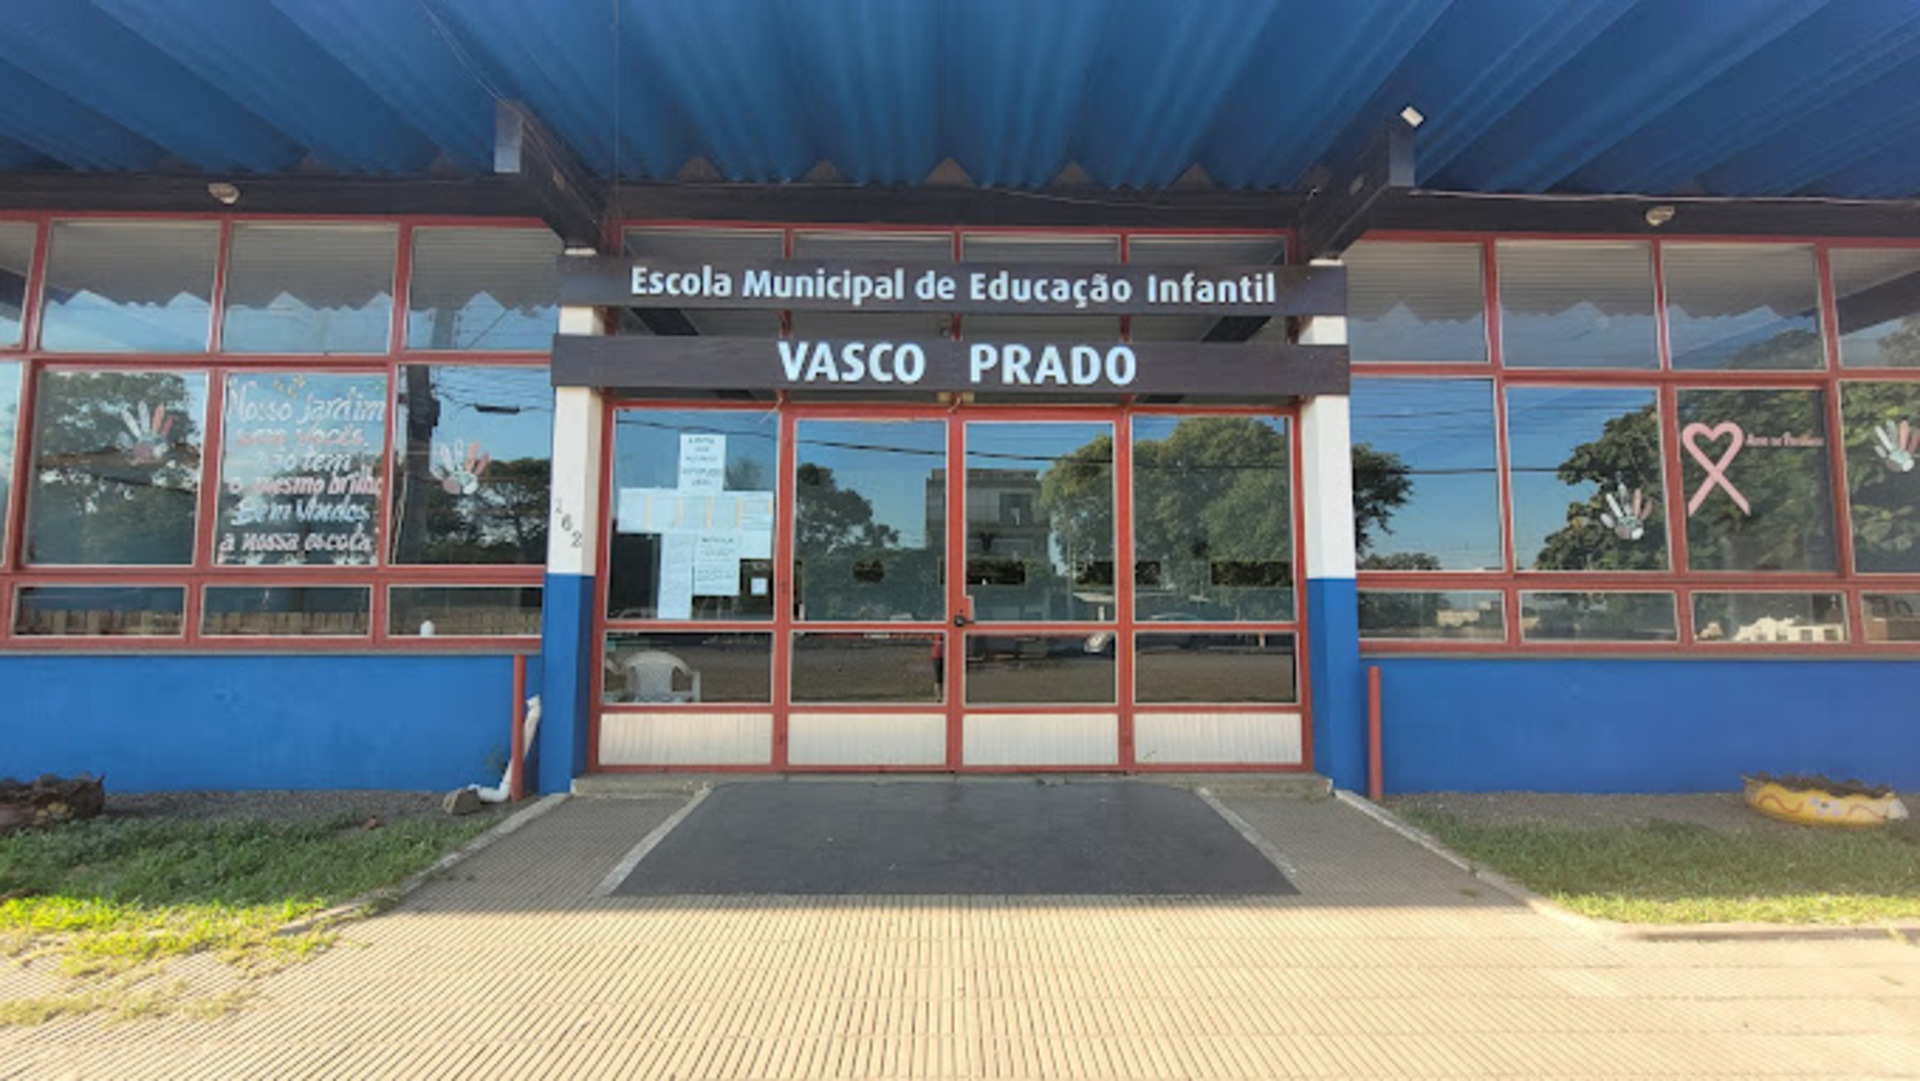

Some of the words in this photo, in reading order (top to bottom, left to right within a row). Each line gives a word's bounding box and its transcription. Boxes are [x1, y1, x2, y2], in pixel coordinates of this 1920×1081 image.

[631, 265, 732, 297] Escola
[742, 268, 904, 306] Municipal
[915, 270, 957, 300] de
[969, 271, 1133, 308] Educação
[1147, 272, 1275, 303] Infantil
[777, 341, 926, 384] VASCO
[969, 343, 1138, 386] PRADO
[227, 378, 292, 422] Nosso
[296, 386, 385, 424] jardim
[301, 446, 351, 472] tem
[253, 476, 325, 496] mesmo
[242, 532, 300, 552] nossa
